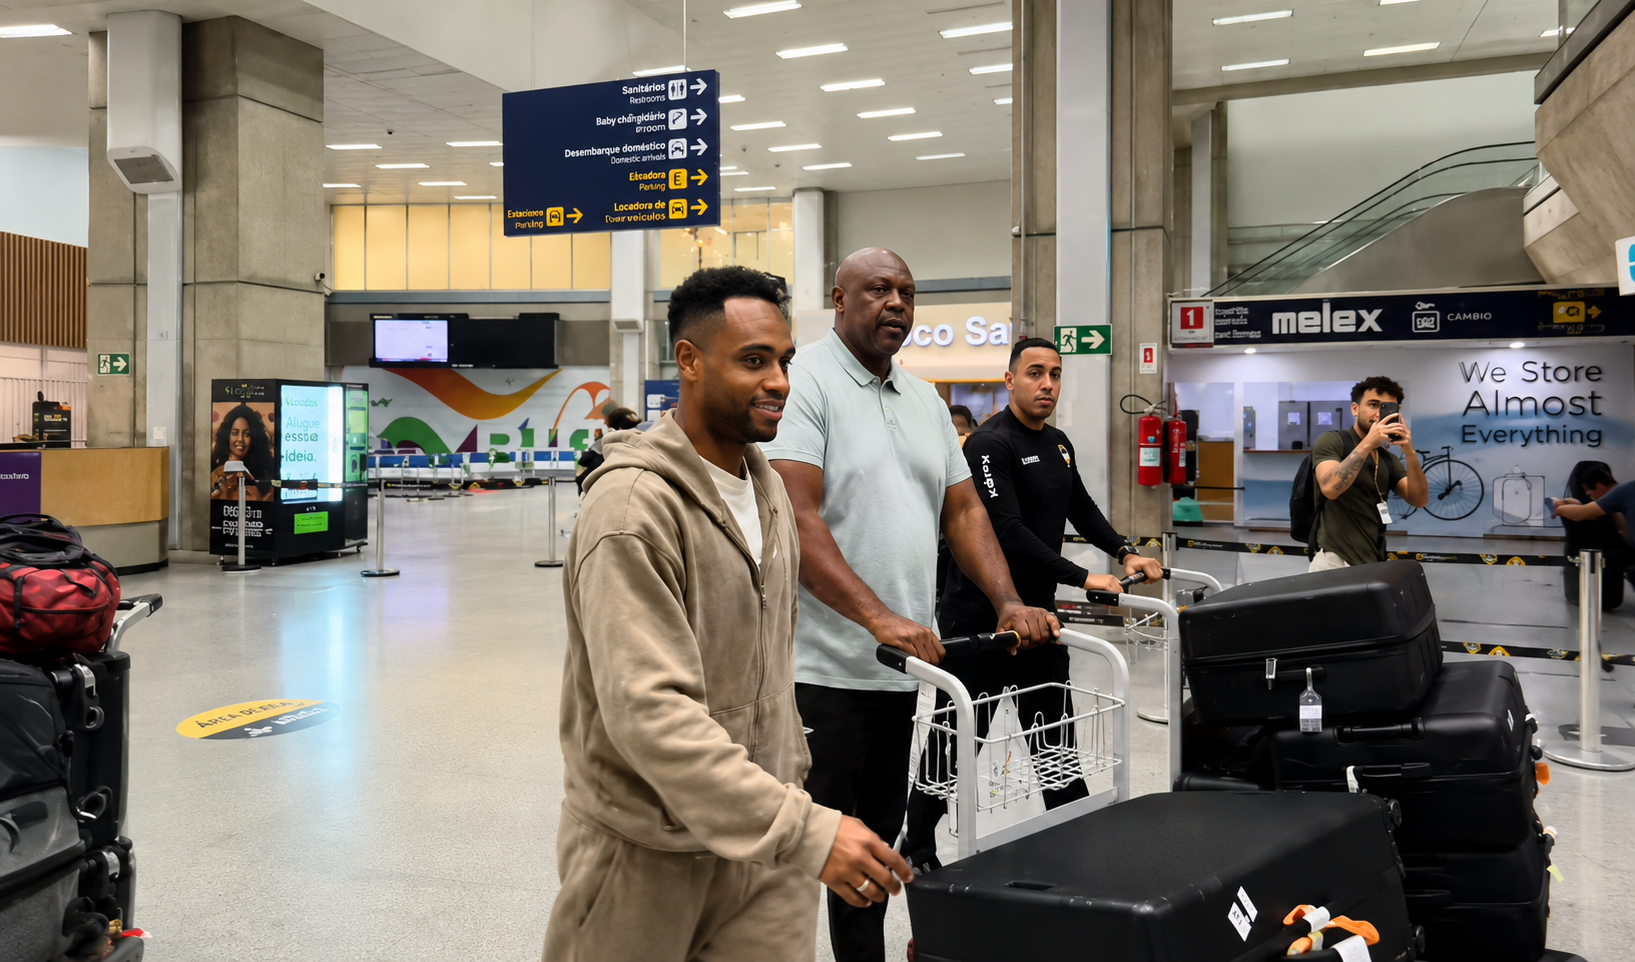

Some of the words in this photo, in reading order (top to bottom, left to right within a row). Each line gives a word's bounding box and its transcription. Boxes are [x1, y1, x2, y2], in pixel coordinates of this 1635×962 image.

[622, 83, 666, 95] Sanitários
[596, 116, 617, 127] Baby
[564, 146, 621, 158] Desembarque
[1186, 309, 1195, 327] 1
[1272, 302, 1384, 335] melex
[1446, 312, 1493, 321] CAMBIO
[902, 323, 955, 347] co
[964, 315, 1014, 347] Sa
[1459, 360, 1507, 384] We
[1521, 360, 1603, 383] Store
[1461, 389, 1603, 418] Almost
[285, 416, 321, 432] Alugue
[1461, 424, 1603, 448] Everything
